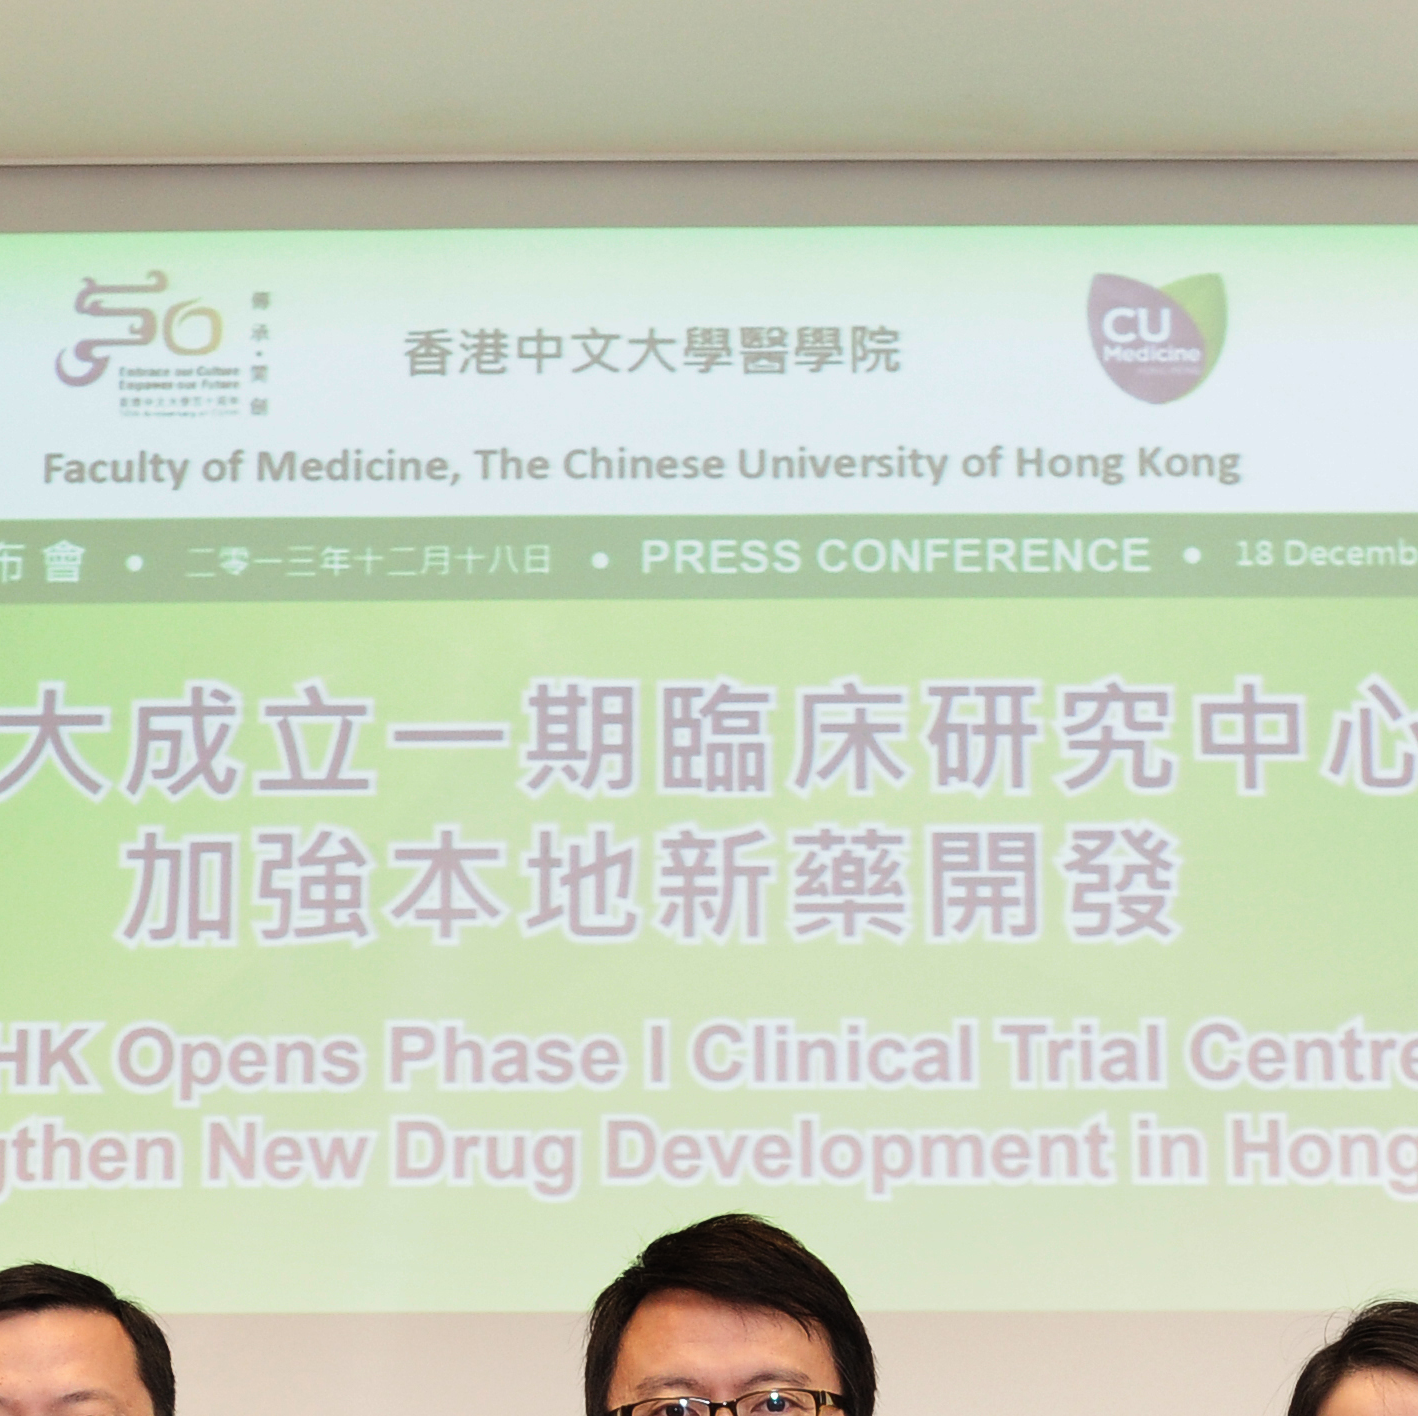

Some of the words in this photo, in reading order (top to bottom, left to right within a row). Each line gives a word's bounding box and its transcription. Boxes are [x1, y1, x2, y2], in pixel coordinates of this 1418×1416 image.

[1102, 307, 1171, 343] CU
[404, 326, 901, 376] 香港中文大學醫學院
[1102, 345, 1201, 363] Medicine
[43, 451, 189, 491] Faculty
[201, 449, 245, 483] of
[257, 449, 460, 486] Medicine,
[474, 449, 549, 481] The
[563, 447, 725, 481] Chinese
[738, 446, 949, 486] University
[962, 445, 1005, 479] of
[1016, 447, 1124, 486] Hong
[1137, 446, 1242, 486] Kong
[186, 544, 551, 578] 二零一三年十二月十八日
[641, 539, 802, 574] PRESS
[816, 537, 1151, 573] CONFERENCE
[1235, 539, 1274, 567] 18
[121, 826, 1180, 941] 加強本地新藥開發
[118, 1025, 363, 1101] Opens
[387, 1024, 621, 1086] Phase
[647, 1023, 666, 1085] I
[690, 1021, 975, 1084] Clinical
[1000, 1021, 1163, 1083] Trial
[207, 1120, 372, 1184] New
[393, 1119, 579, 1197] Drug
[604, 1114, 1112, 1196] Development
[1136, 1117, 1200, 1181] in
